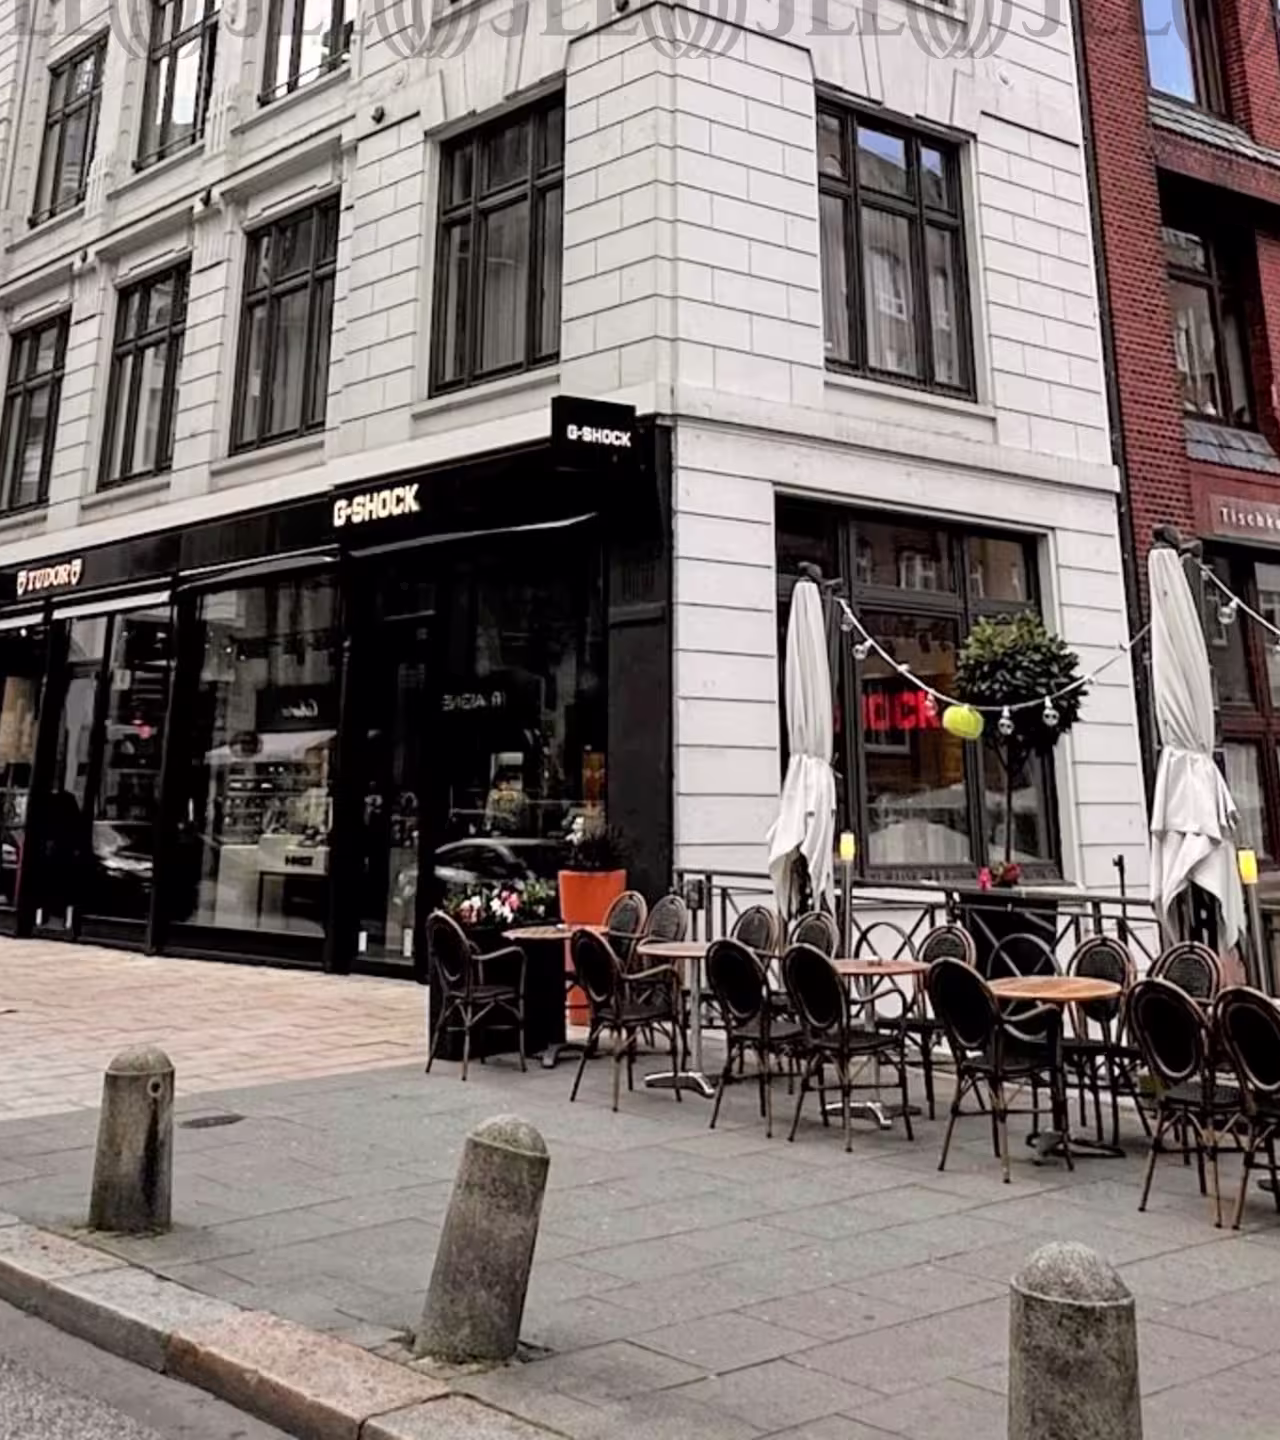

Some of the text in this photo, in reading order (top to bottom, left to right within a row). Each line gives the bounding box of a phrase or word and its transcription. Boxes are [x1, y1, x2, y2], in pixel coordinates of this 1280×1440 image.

[567, 424, 631, 447] G-SHOCK
[333, 483, 420, 528] G-SHOCK
[26, 562, 70, 592] TUDOR
